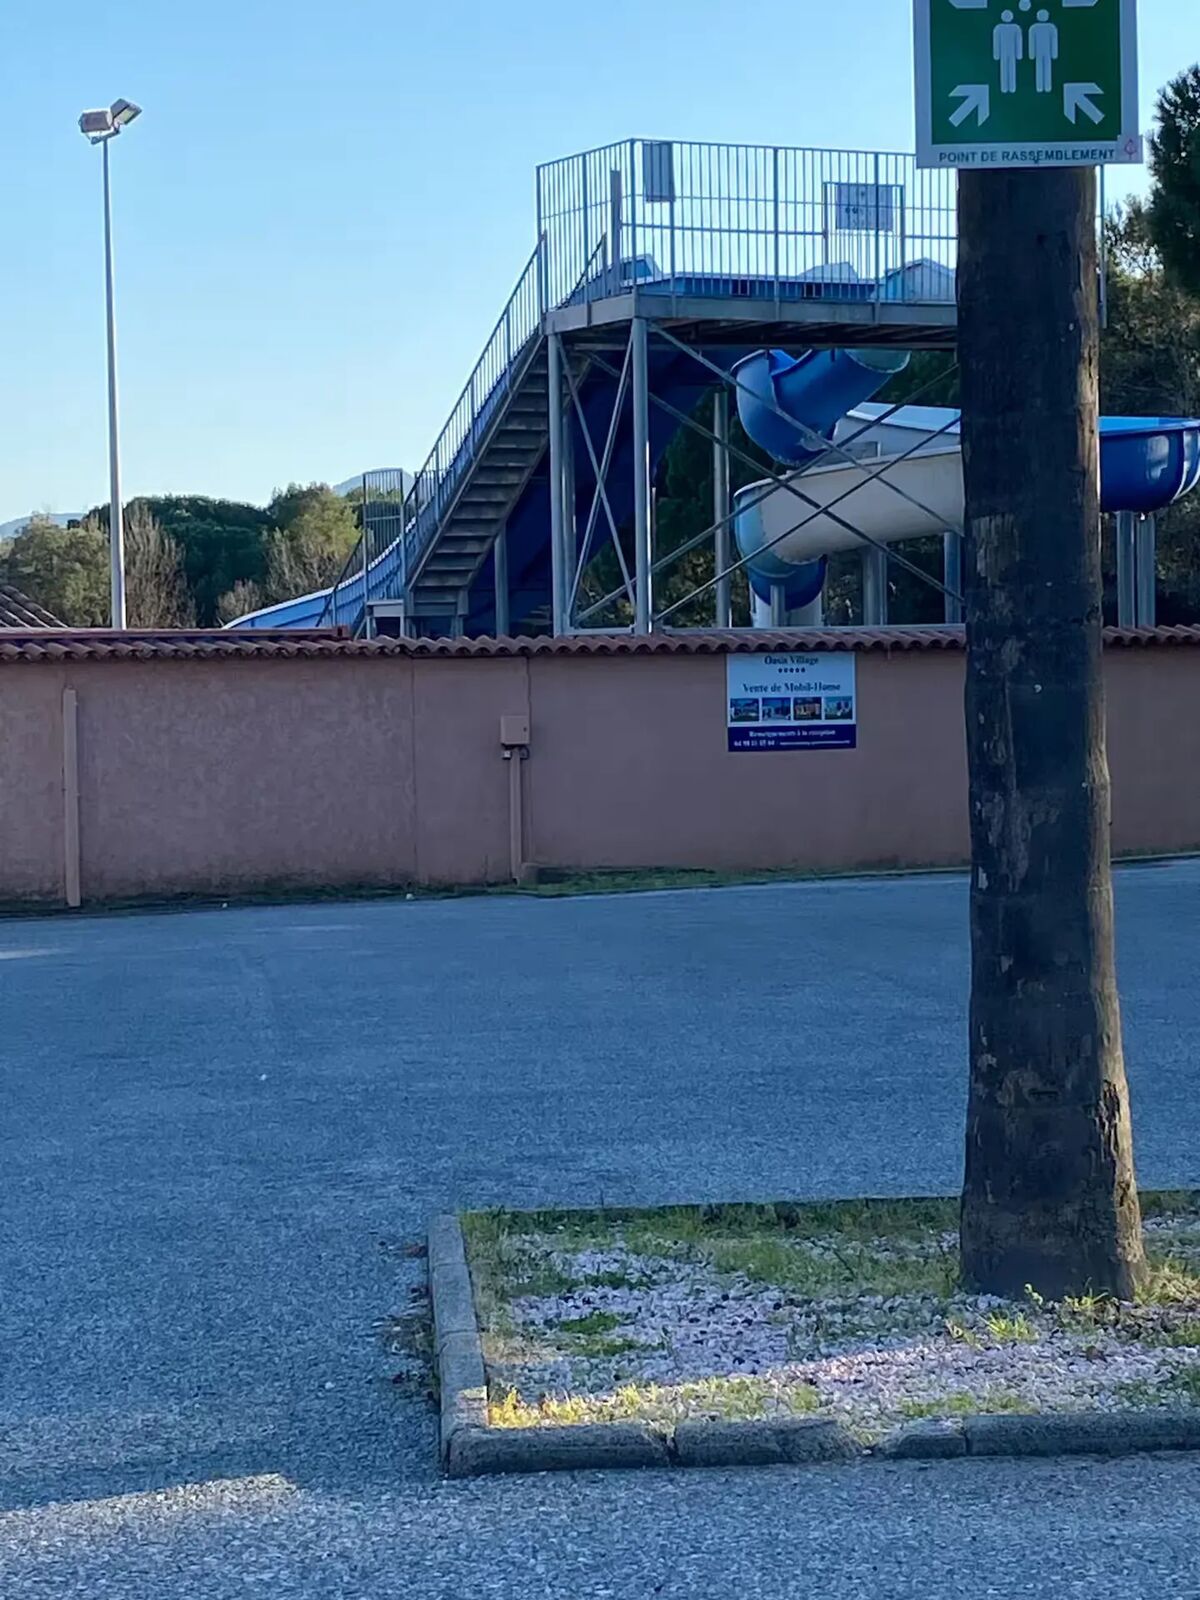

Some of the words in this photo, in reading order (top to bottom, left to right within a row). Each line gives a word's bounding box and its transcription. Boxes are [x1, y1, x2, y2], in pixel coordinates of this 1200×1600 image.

[939, 152, 975, 163] POINT
[981, 151, 997, 162] DE
[1001, 149, 1115, 162] RASSEMBLEMENT
[764, 655, 788, 665] Oasis
[789, 655, 819, 666] Village
[743, 683, 768, 693] Vente
[770, 683, 782, 692] de
[784, 681, 841, 692] Mobil-Home
